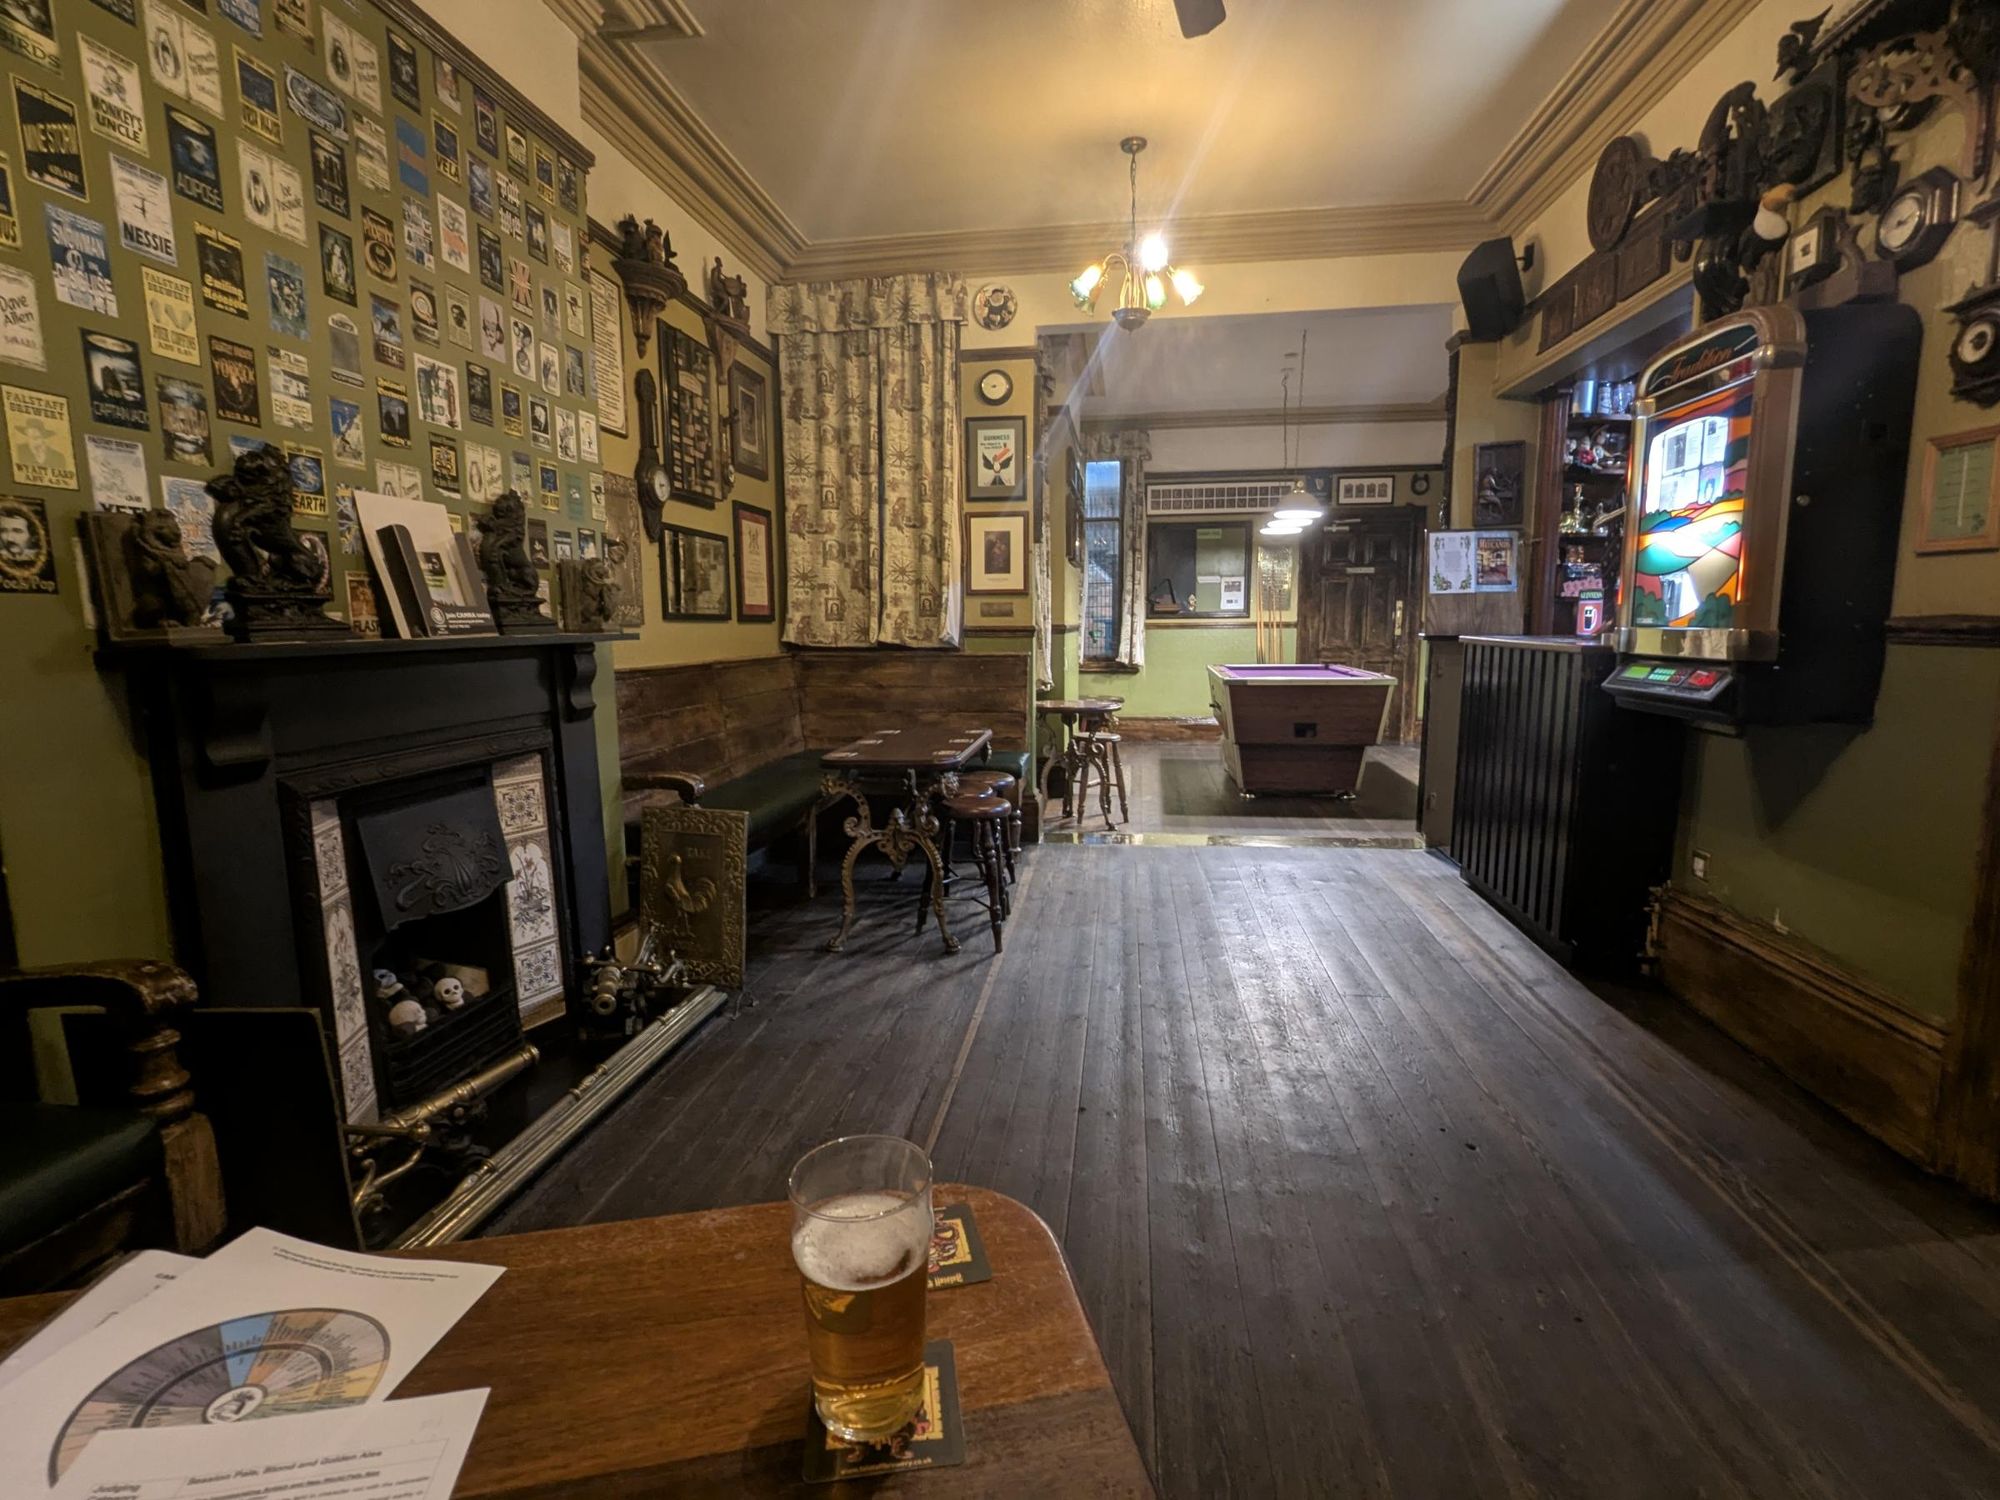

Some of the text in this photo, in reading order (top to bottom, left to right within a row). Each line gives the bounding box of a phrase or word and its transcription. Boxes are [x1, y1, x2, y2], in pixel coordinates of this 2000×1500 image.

[91, 93, 143, 131] MONKEY'S
[96, 111, 141, 144] UNCLE
[436, 155, 459, 181] VELA
[123, 221, 173, 257] NESSIE
[144, 272, 191, 293] FALSTAFF
[147, 283, 190, 304] BREWERY
[0, 295, 28, 313] Dave
[4, 311, 35, 326] Allen
[5, 391, 65, 411] FALSTAFF
[9, 401, 64, 421] BREWERY
[15, 463, 75, 479] WYATT EARP
[293, 493, 326, 513] EARTH
[187, 1474, 231, 1486] Session
[297, 1459, 318, 1469] and
[319, 1453, 357, 1466] Golden
[358, 1450, 383, 1460] Ales
[93, 1484, 141, 1494] Judging
